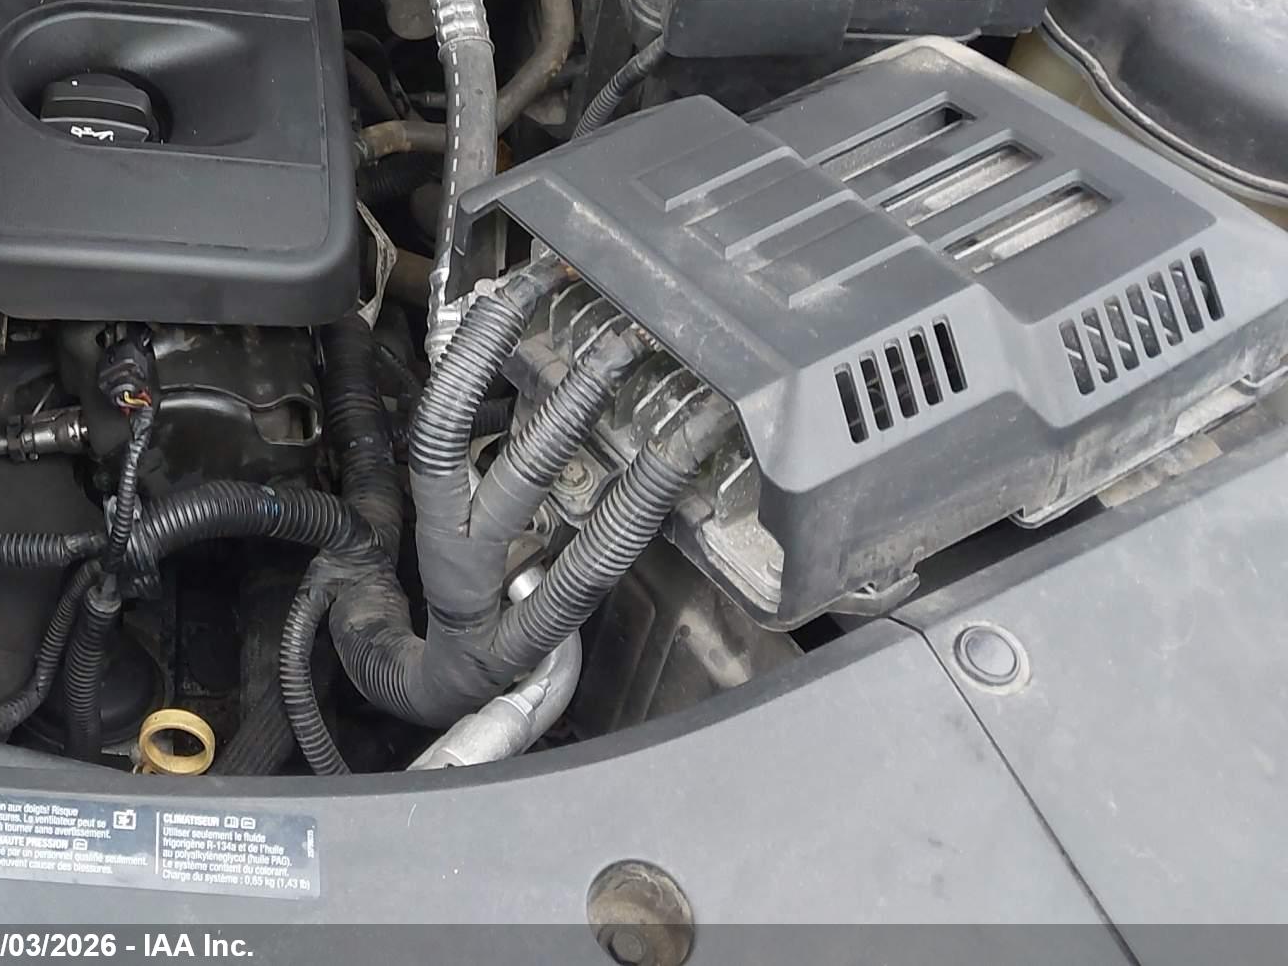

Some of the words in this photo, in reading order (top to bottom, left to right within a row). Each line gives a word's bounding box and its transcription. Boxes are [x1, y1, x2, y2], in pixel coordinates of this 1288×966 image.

[8, 804, 22, 812] aux
[24, 804, 49, 814] doigts!
[52, 806, 78, 816] Risque
[23, 814, 33, 822] Le
[34, 814, 76, 826] ventilateur
[78, 818, 95, 828] peut
[97, 820, 106, 828] se
[163, 813, 219, 827] CLIMATISEUR
[5, 824, 32, 833] tourner
[34, 826, 53, 834] sans
[55, 826, 111, 839] avertissement.
[163, 827, 190, 838] Utiliser
[192, 829, 233, 840] seulement
[234, 831, 242, 841] le
[244, 832, 266, 842] fluide
[26, 837, 68, 849] PRESSION
[163, 837, 204, 850] frigorigène
[206, 840, 236, 852] R-134a
[238, 842, 246, 852] et
[248, 843, 258, 852] de
[260, 844, 284, 855] l'huile
[8, 849, 20, 858] par
[34, 850, 72, 861] personnel
[248, 854, 269, 865] (huile
[271, 856, 292, 868] PAG).
[29, 860, 55, 869] causer
[58, 861, 71, 871] des
[74, 862, 112, 874] blessures.
[163, 859, 173, 868] Le
[175, 860, 207, 872] système
[209, 862, 241, 873] contient
[243, 864, 253, 874] du
[255, 866, 289, 877] colorant.
[163, 869, 190, 882] Charge
[192, 871, 202, 880] du
[204, 872, 238, 884] système
[265, 877, 275, 888] kg
[300, 879, 310, 891] lb)
